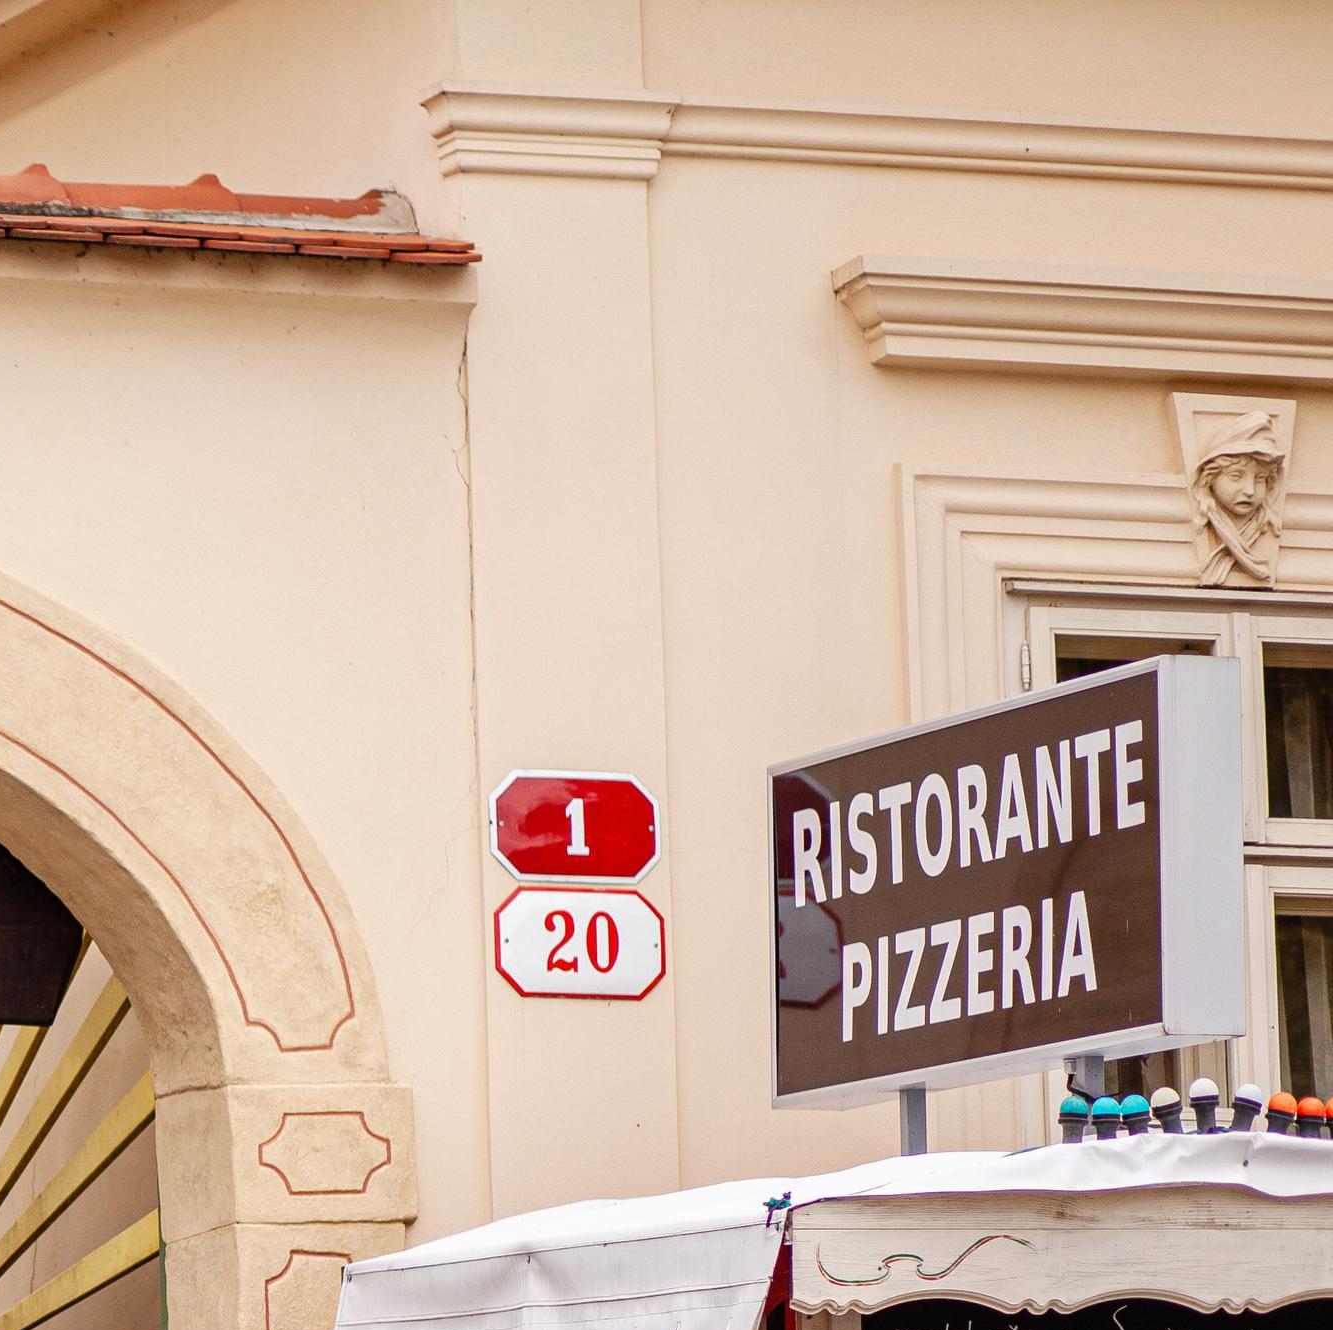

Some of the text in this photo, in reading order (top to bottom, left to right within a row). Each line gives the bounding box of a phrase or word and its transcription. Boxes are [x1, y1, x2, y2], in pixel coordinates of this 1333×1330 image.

[565, 798, 590, 856] 1
[793, 719, 1146, 908] RISTORANTE
[544, 910, 619, 973] 20
[842, 890, 1098, 1043] PIZZERIA
